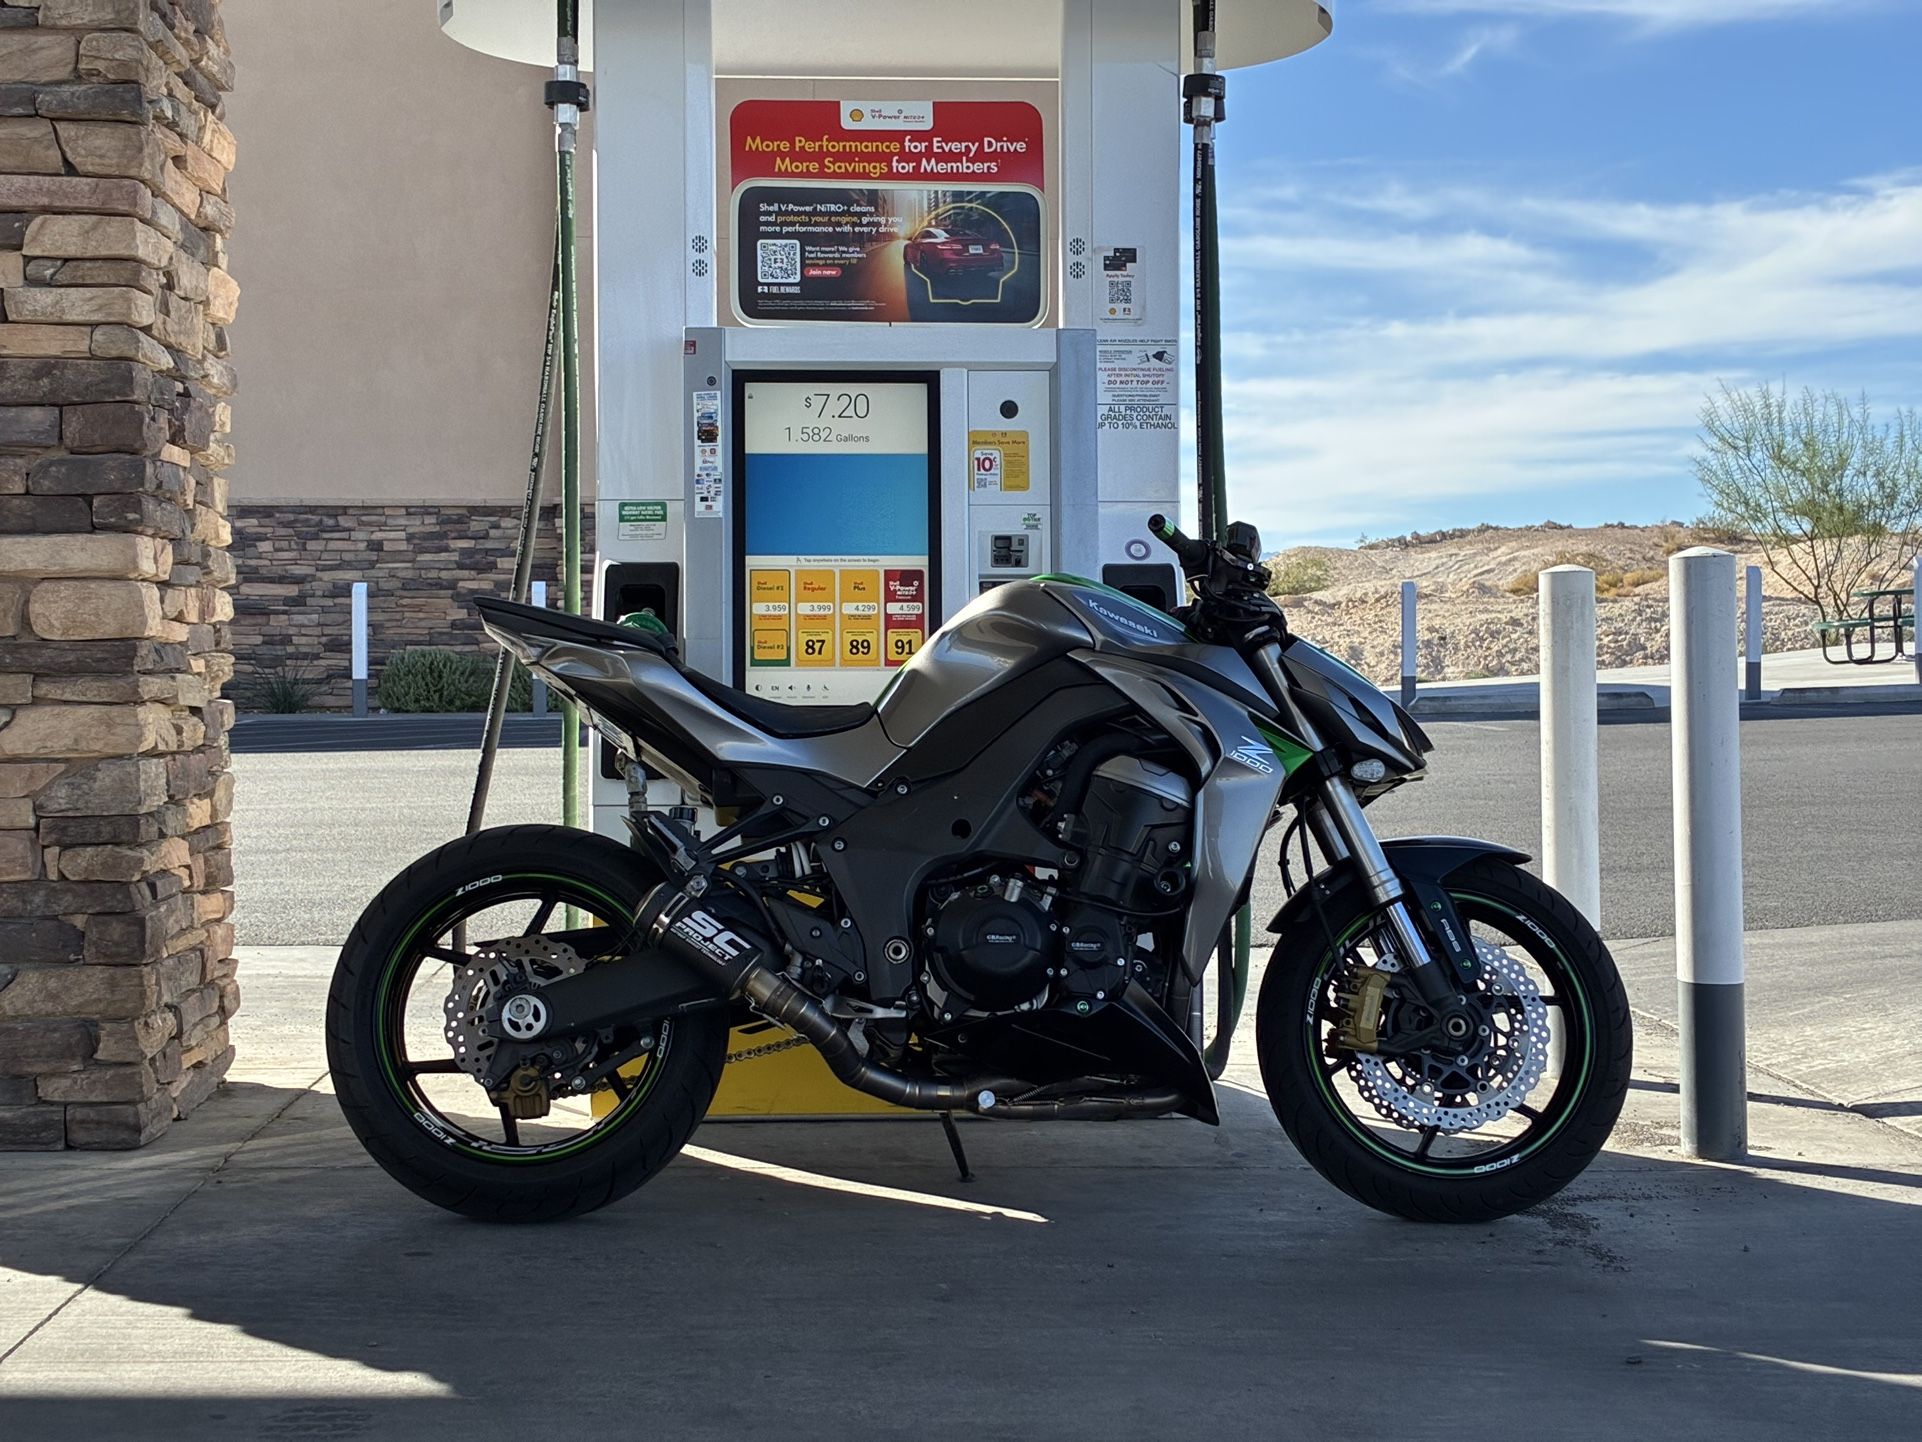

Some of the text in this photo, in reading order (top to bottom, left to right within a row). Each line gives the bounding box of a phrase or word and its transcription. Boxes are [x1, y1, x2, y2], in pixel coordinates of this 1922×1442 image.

[745, 136, 790, 152] More
[795, 135, 900, 152] Performance
[904, 136, 928, 152] for
[933, 137, 979, 157] Every
[775, 157, 819, 173] More
[824, 157, 888, 177] Savings
[892, 156, 916, 173] for
[759, 203, 779, 212] Shell
[850, 203, 875, 212] cleans
[759, 213, 903, 224] and protects your engine, giving you
[782, 223, 833, 234] performance
[835, 224, 853, 232] with
[854, 226, 877, 235] every
[804, 393, 870, 419] $7.20
[1100, 413, 1172, 422] GRADES CONTAIN
[1121, 422, 1137, 430] 10%
[784, 426, 870, 443] 1.582 Gallons
[1088, 599, 1158, 638] Kawasaki
[805, 639, 826, 655] 87
[849, 639, 871, 655] 89
[894, 639, 915, 655] 91
[1237, 736, 1273, 765] Z
[1230, 750, 1274, 774] 1000
[455, 874, 503, 897] Z1000
[675, 921, 733, 960] PROJECT
[682, 910, 752, 957] SC
[1441, 918, 1461, 953] ABS
[1515, 913, 1556, 948] Z1000
[1306, 976, 1322, 1025] Z1000
[413, 1112, 457, 1145] Z1000
[1473, 1153, 1520, 1173] Z1000
